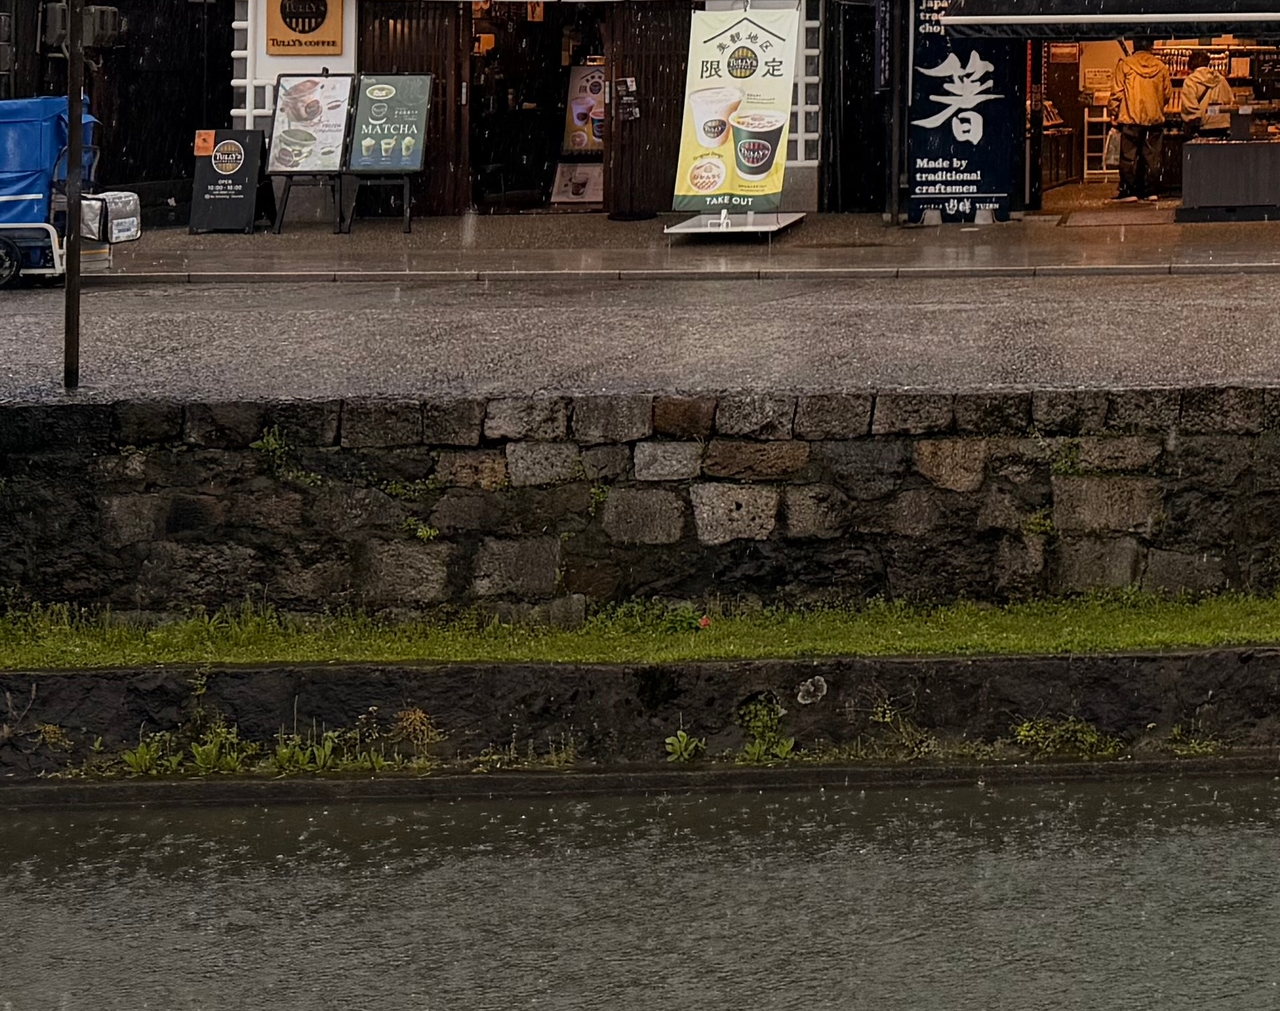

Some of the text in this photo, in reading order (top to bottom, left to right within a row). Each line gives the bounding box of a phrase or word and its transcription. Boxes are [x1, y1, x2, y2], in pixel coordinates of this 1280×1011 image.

[911, 50, 1005, 145] 箸
[361, 124, 418, 134] MATCHA
[916, 158, 968, 170] Made by
[915, 171, 981, 181] traditional
[915, 183, 977, 193] craftsmen
[705, 196, 753, 206] TAKE OUT
